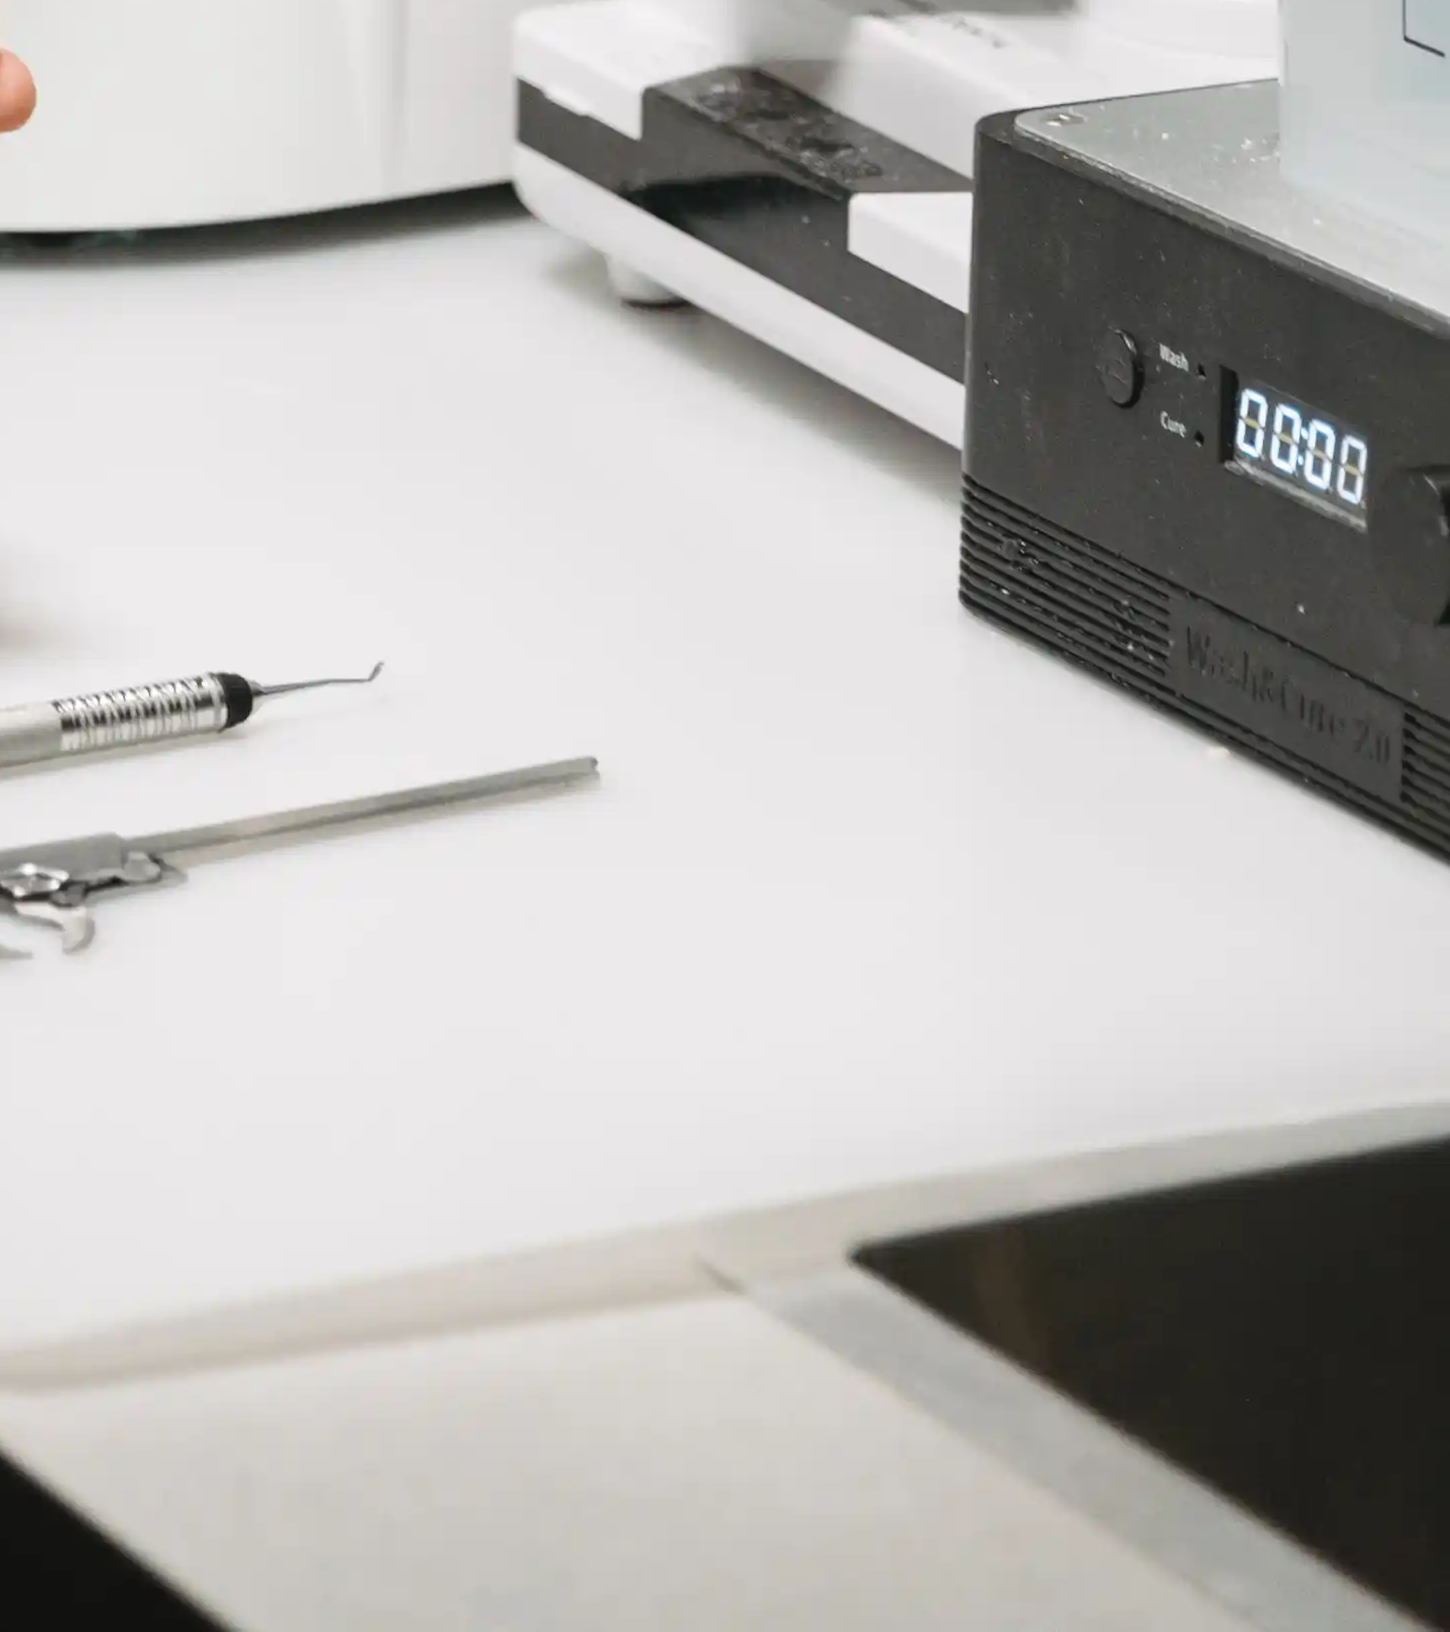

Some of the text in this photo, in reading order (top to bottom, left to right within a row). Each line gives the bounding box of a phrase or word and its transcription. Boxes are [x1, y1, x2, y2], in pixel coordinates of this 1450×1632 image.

[1159, 342, 1189, 372] Wash
[1160, 410, 1187, 438] Cure
[1236, 387, 1368, 505] 00:00
